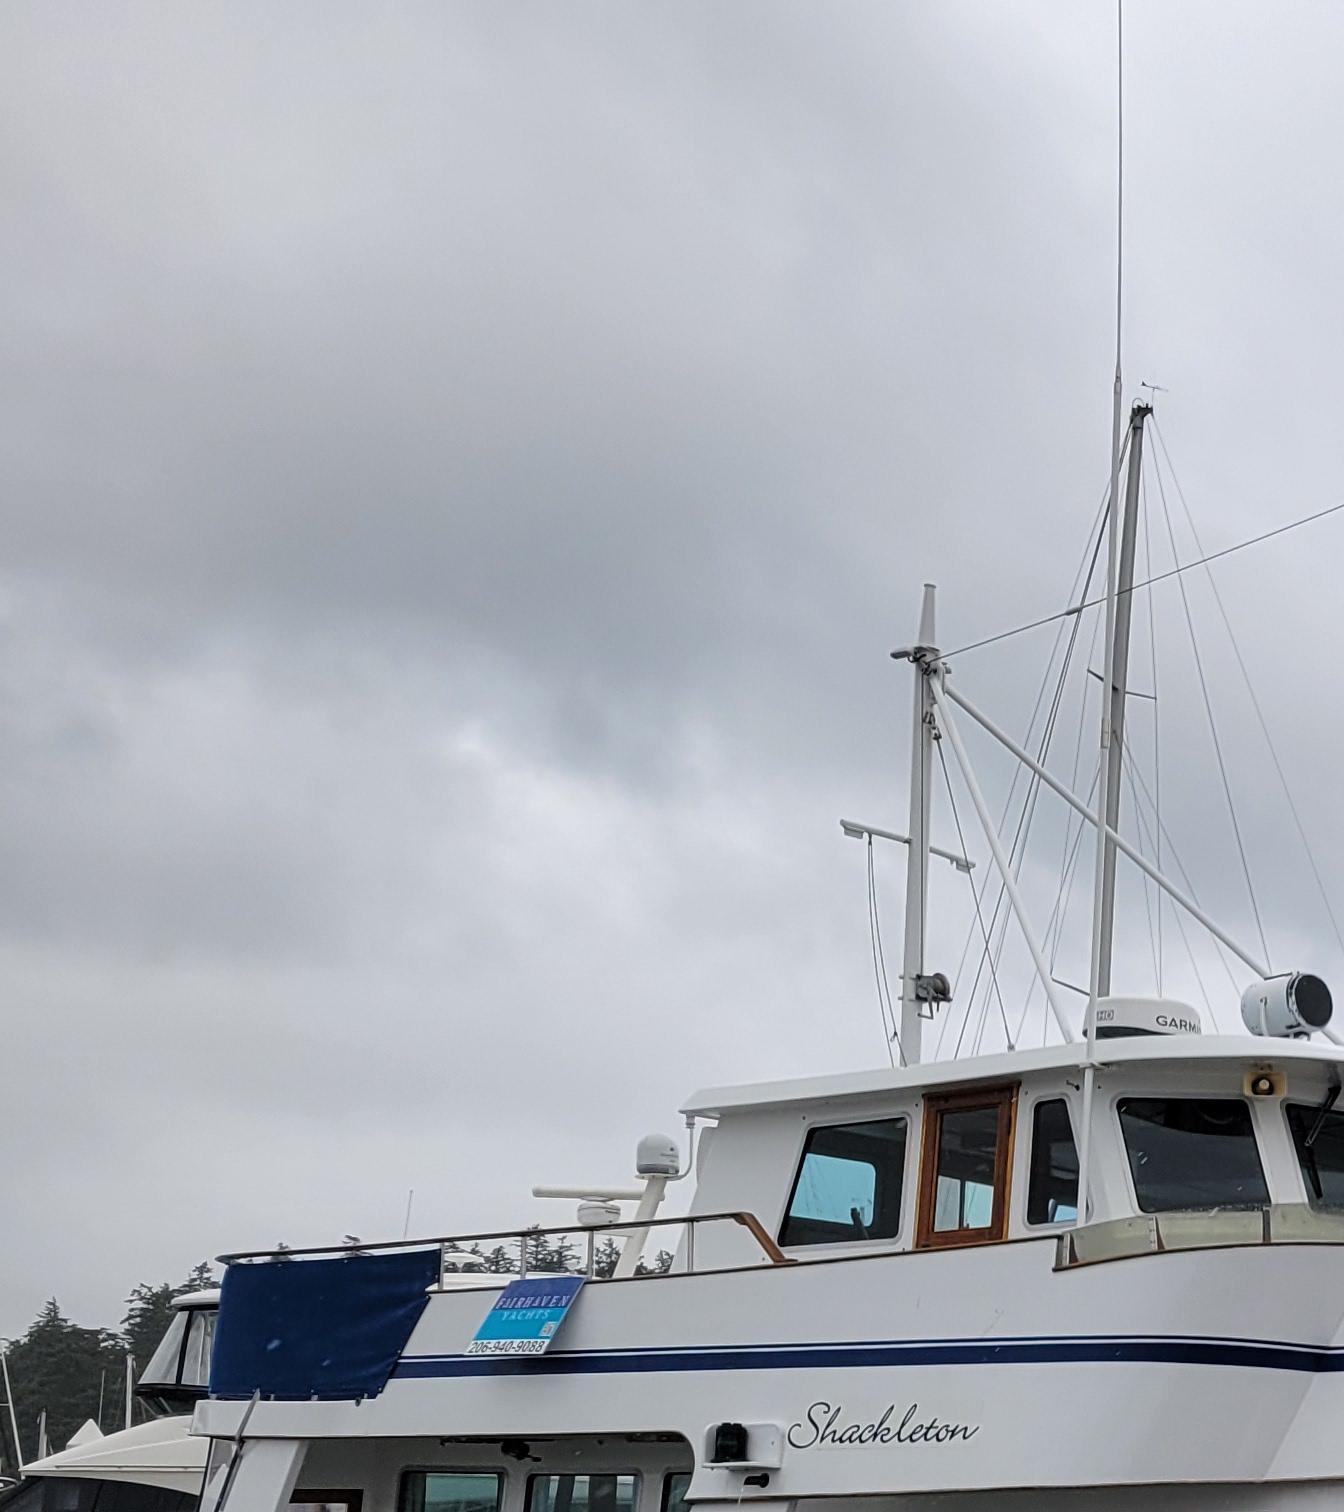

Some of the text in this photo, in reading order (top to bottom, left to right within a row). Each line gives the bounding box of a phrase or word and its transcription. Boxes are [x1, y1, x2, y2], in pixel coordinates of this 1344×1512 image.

[495, 1295, 571, 1310] FAIRHAVEN
[501, 1309, 552, 1321] YACHTS
[466, 1340, 546, 1354] 206-940-9088
[787, 1401, 980, 1449] Shackleton
